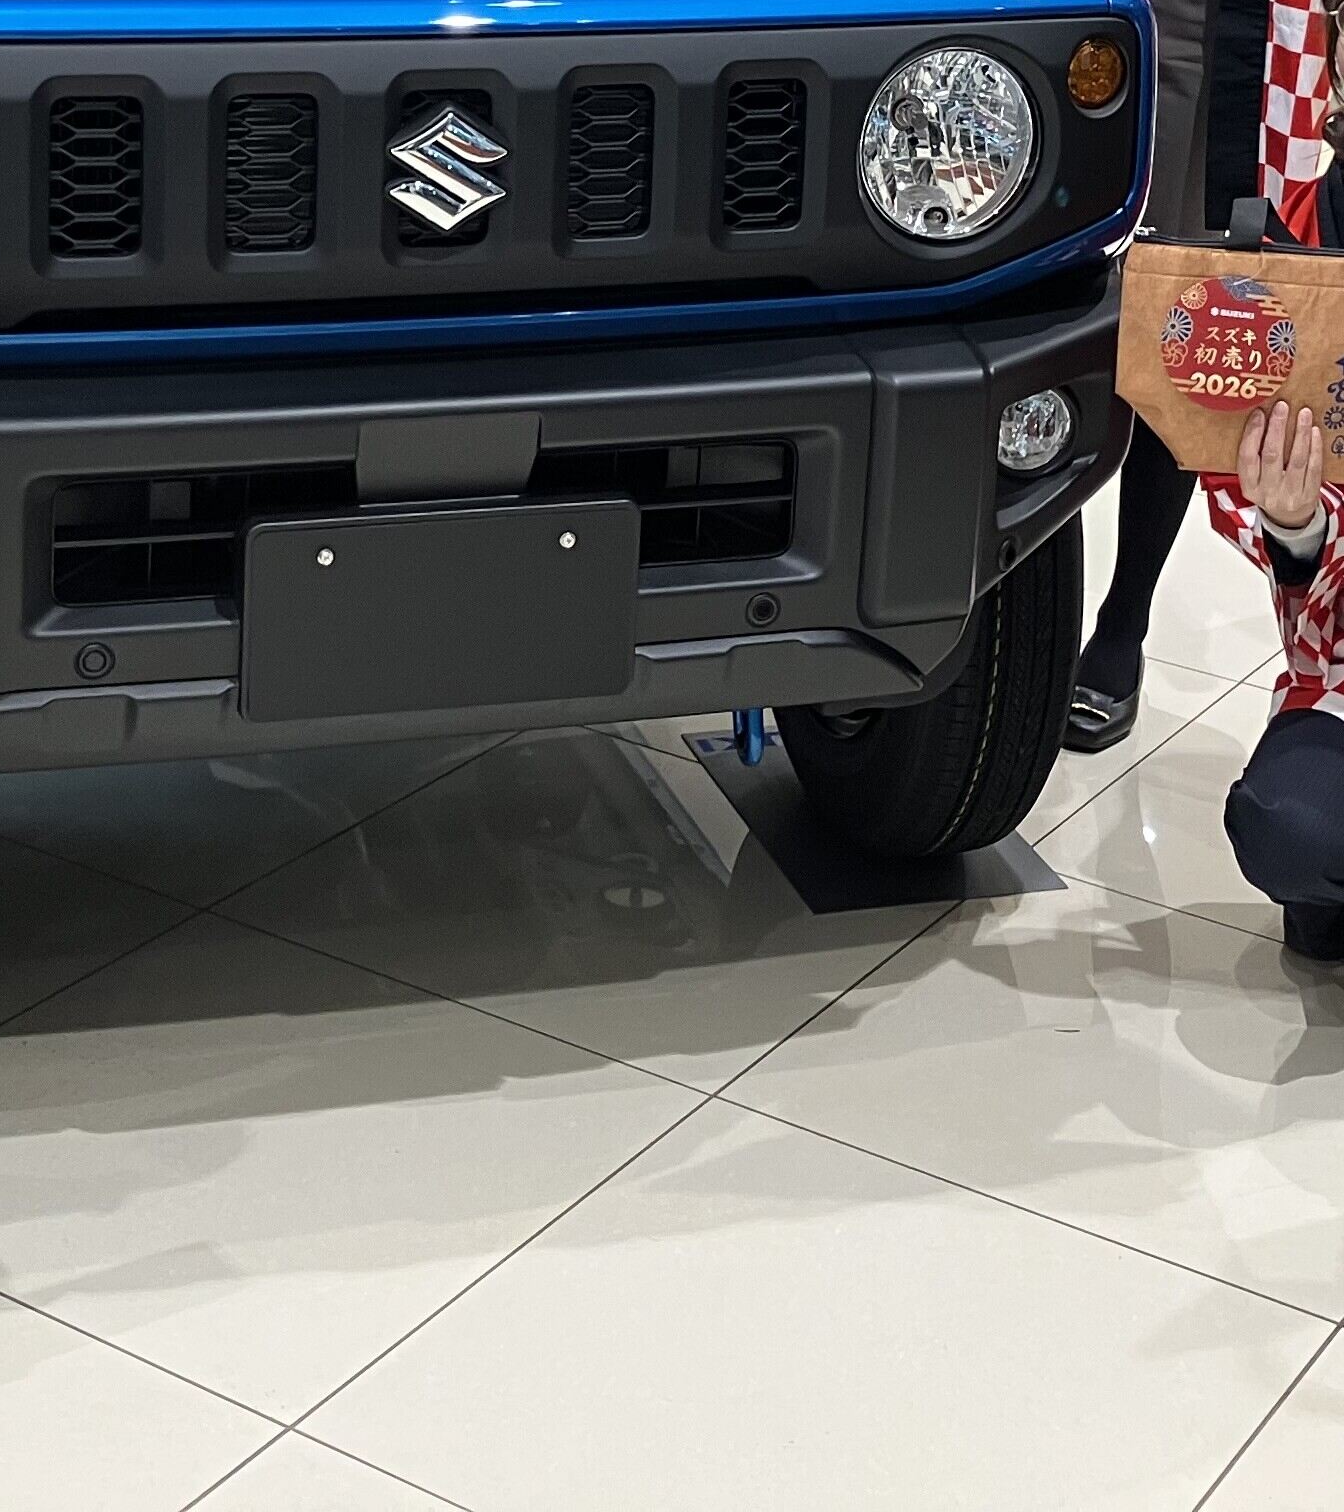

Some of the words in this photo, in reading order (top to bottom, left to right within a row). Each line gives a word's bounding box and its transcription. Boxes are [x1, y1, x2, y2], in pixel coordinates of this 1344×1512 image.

[1205, 326, 1257, 346] スズキ
[1193, 343, 1262, 371] 初売り
[1190, 371, 1257, 399] 2026
